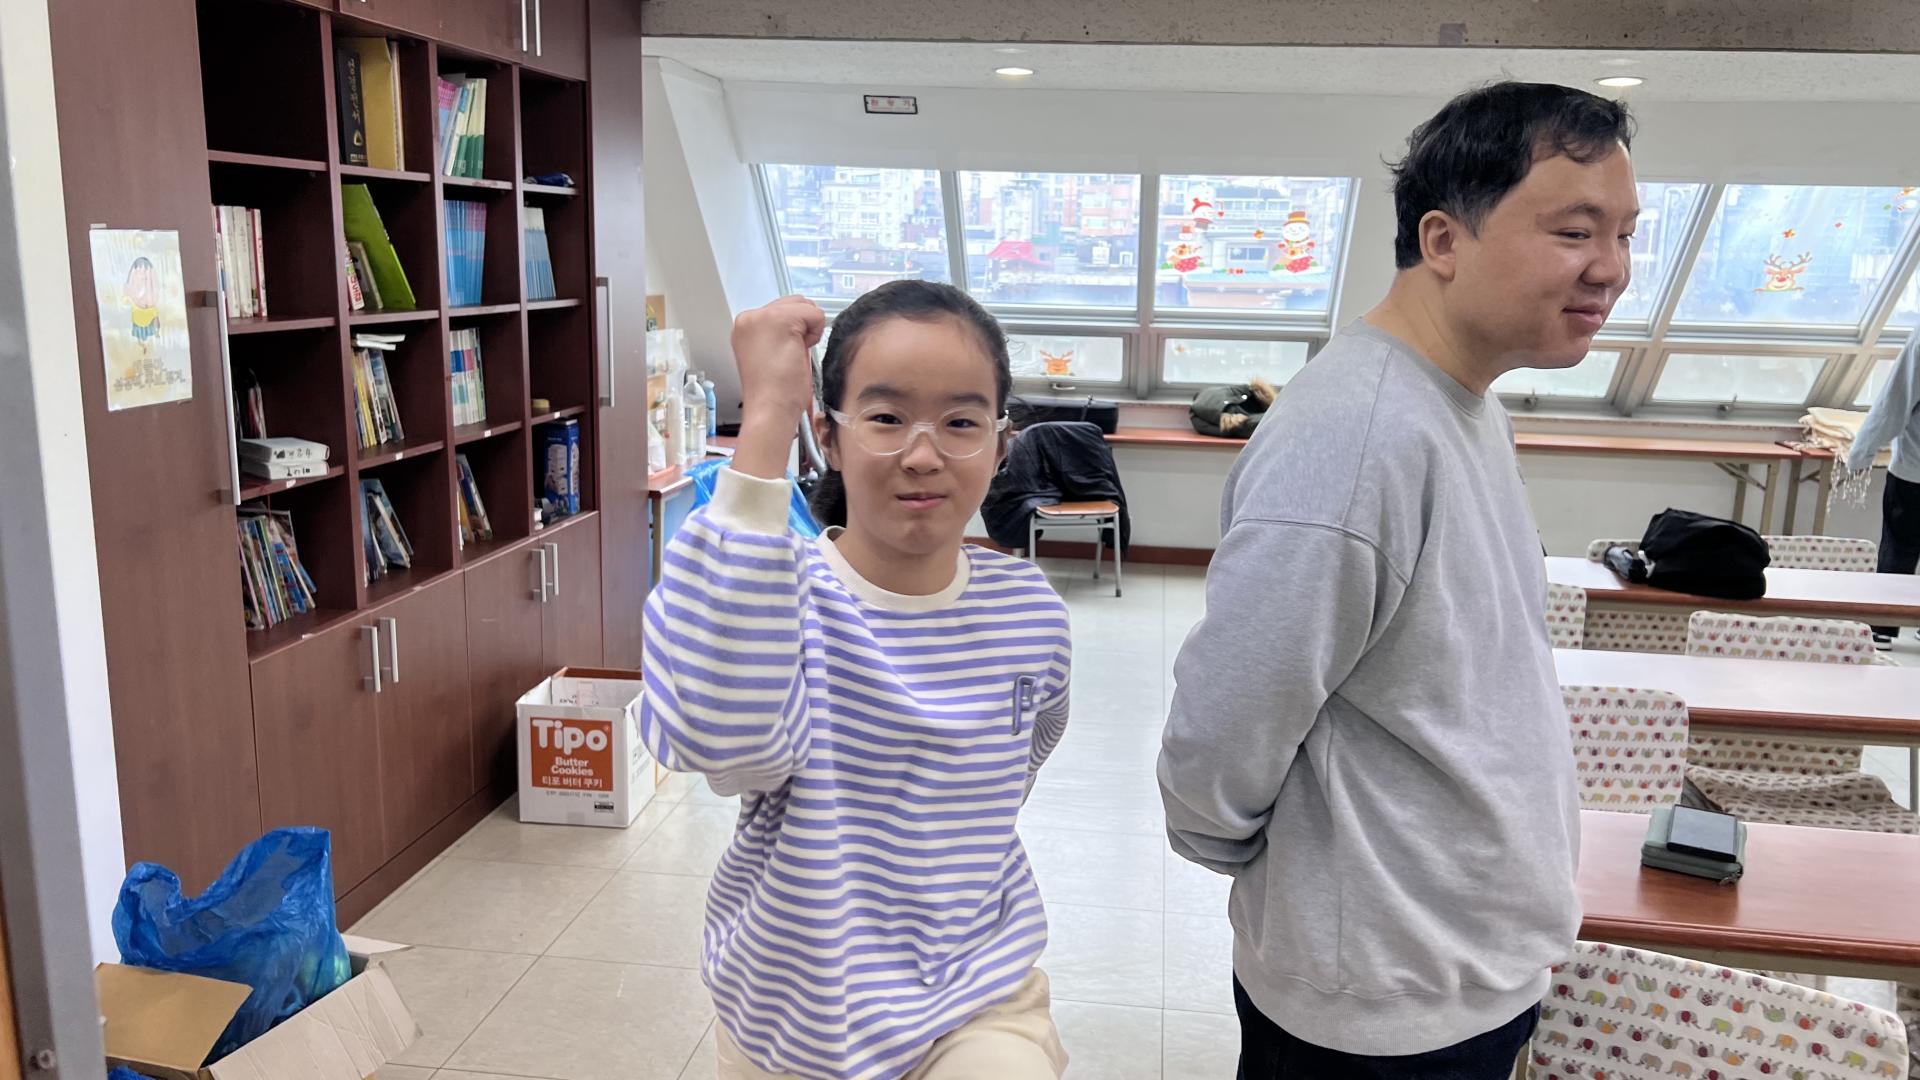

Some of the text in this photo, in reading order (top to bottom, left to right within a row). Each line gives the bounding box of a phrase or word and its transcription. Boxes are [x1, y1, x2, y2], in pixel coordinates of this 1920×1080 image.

[532, 719, 607, 755] Tipo
[555, 756, 589, 767] Butter
[551, 765, 594, 776] Cookies
[562, 776, 581, 788] 버터
[583, 778, 603, 789] 쿠키
